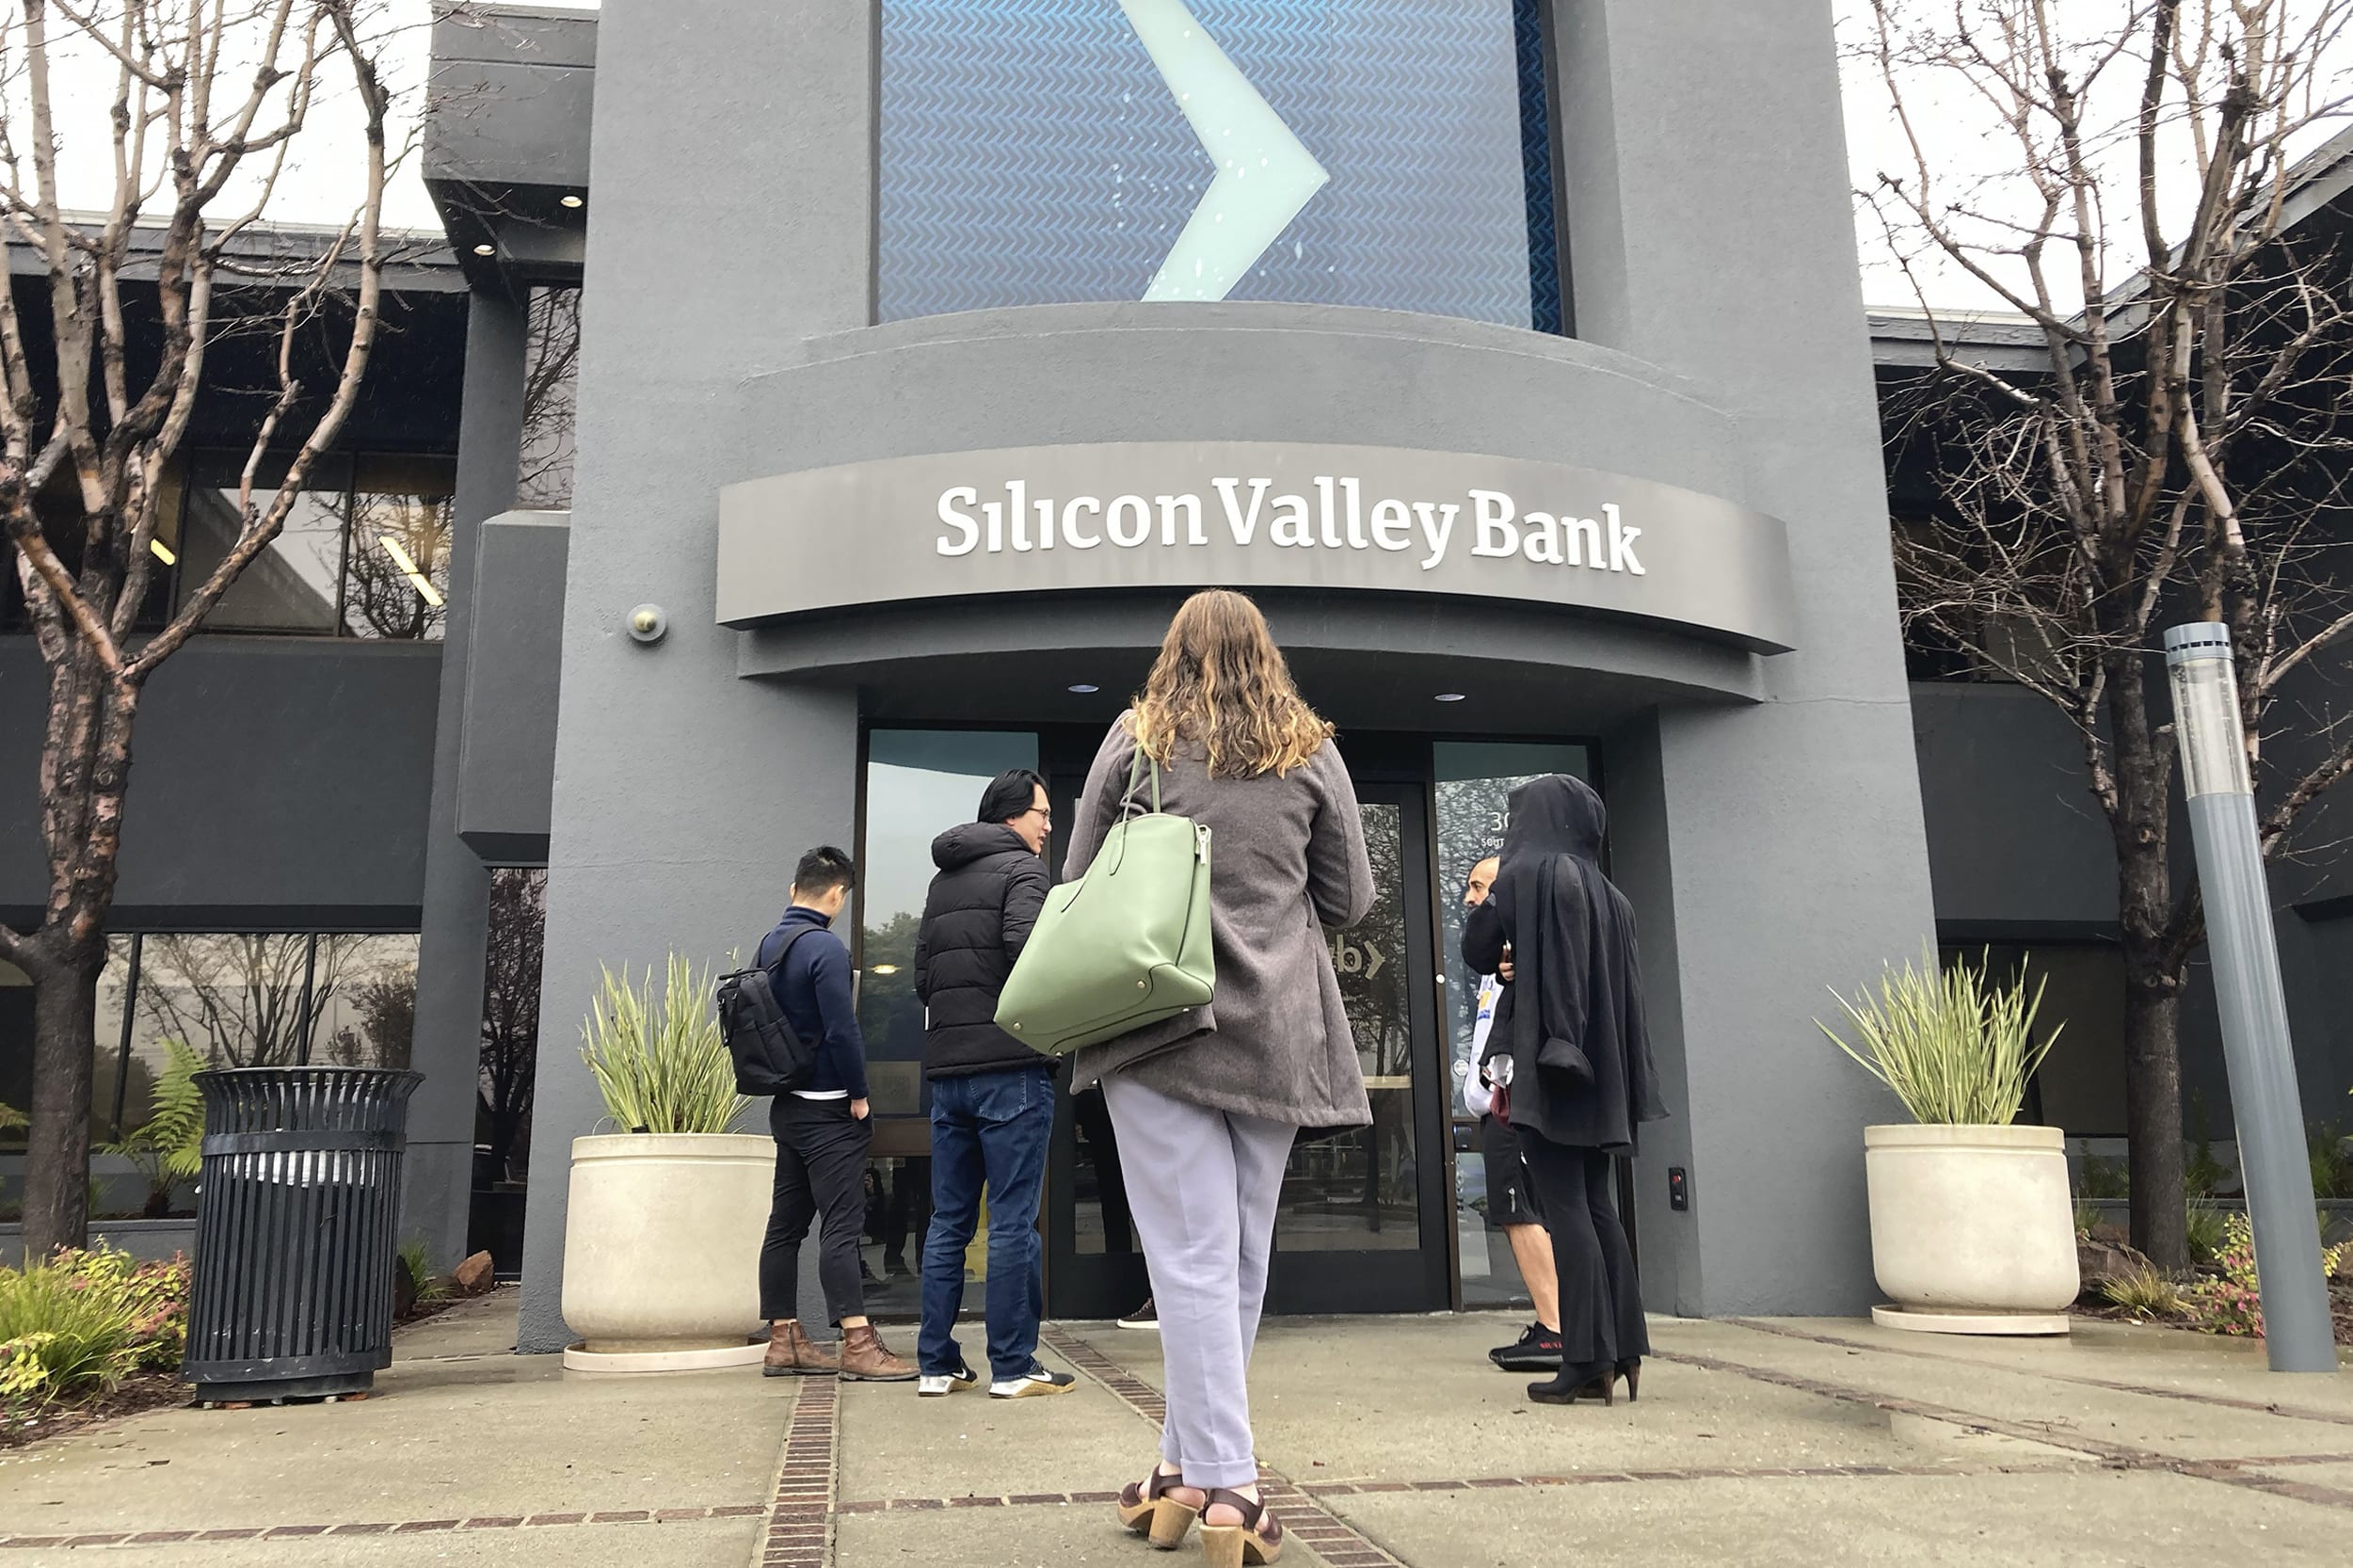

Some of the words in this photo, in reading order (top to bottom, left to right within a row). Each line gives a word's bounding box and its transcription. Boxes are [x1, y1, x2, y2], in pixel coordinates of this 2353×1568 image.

[936, 478, 1209, 557] Silicon
[1211, 474, 1462, 571] Valley
[1468, 488, 1647, 576] Bank
[1481, 838, 1505, 847] SOUT
